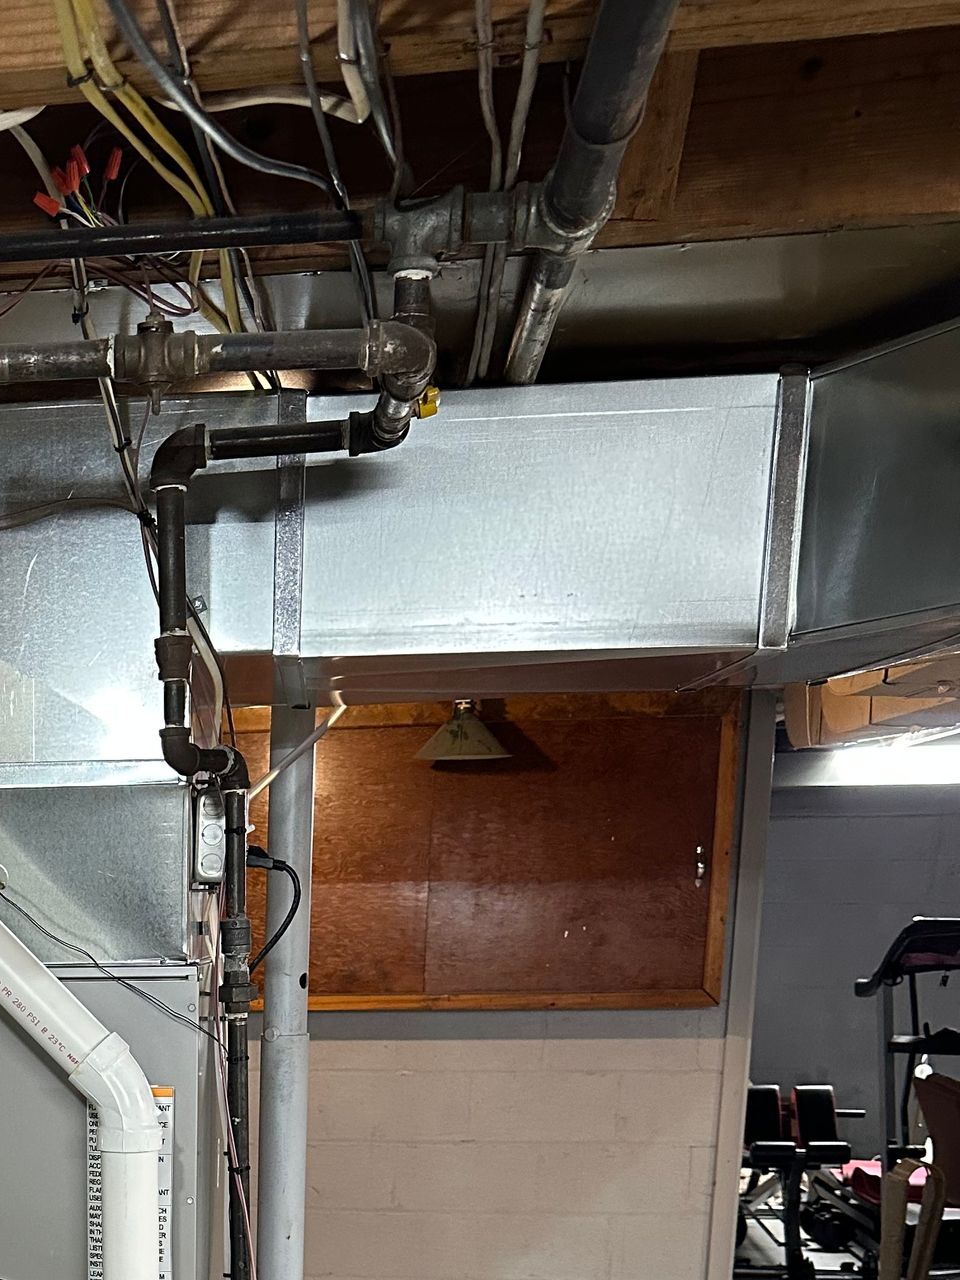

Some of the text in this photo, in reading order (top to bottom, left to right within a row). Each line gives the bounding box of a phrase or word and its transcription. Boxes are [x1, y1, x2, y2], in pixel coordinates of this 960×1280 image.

[1, 986, 13, 998] PR
[12, 997, 27, 1013] 280
[26, 1012, 41, 1027] PSI
